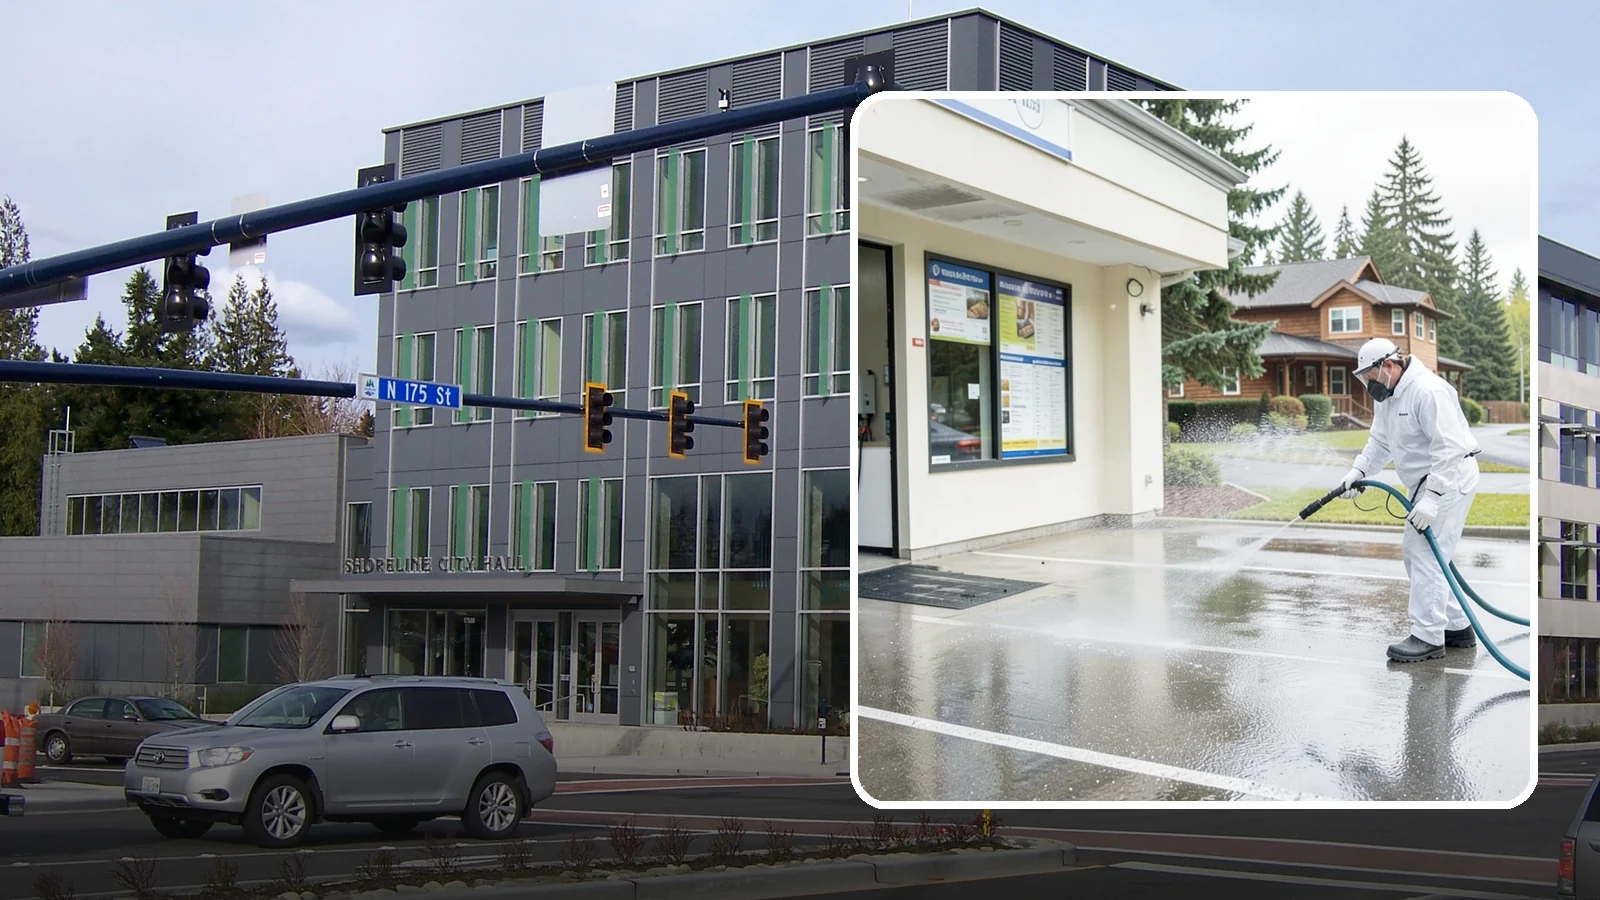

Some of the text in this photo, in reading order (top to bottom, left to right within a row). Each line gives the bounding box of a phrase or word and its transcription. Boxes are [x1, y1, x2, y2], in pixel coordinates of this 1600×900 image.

[387, 380, 451, 406] N 175 St
[344, 555, 525, 574] SHORELINE CITY HALL
